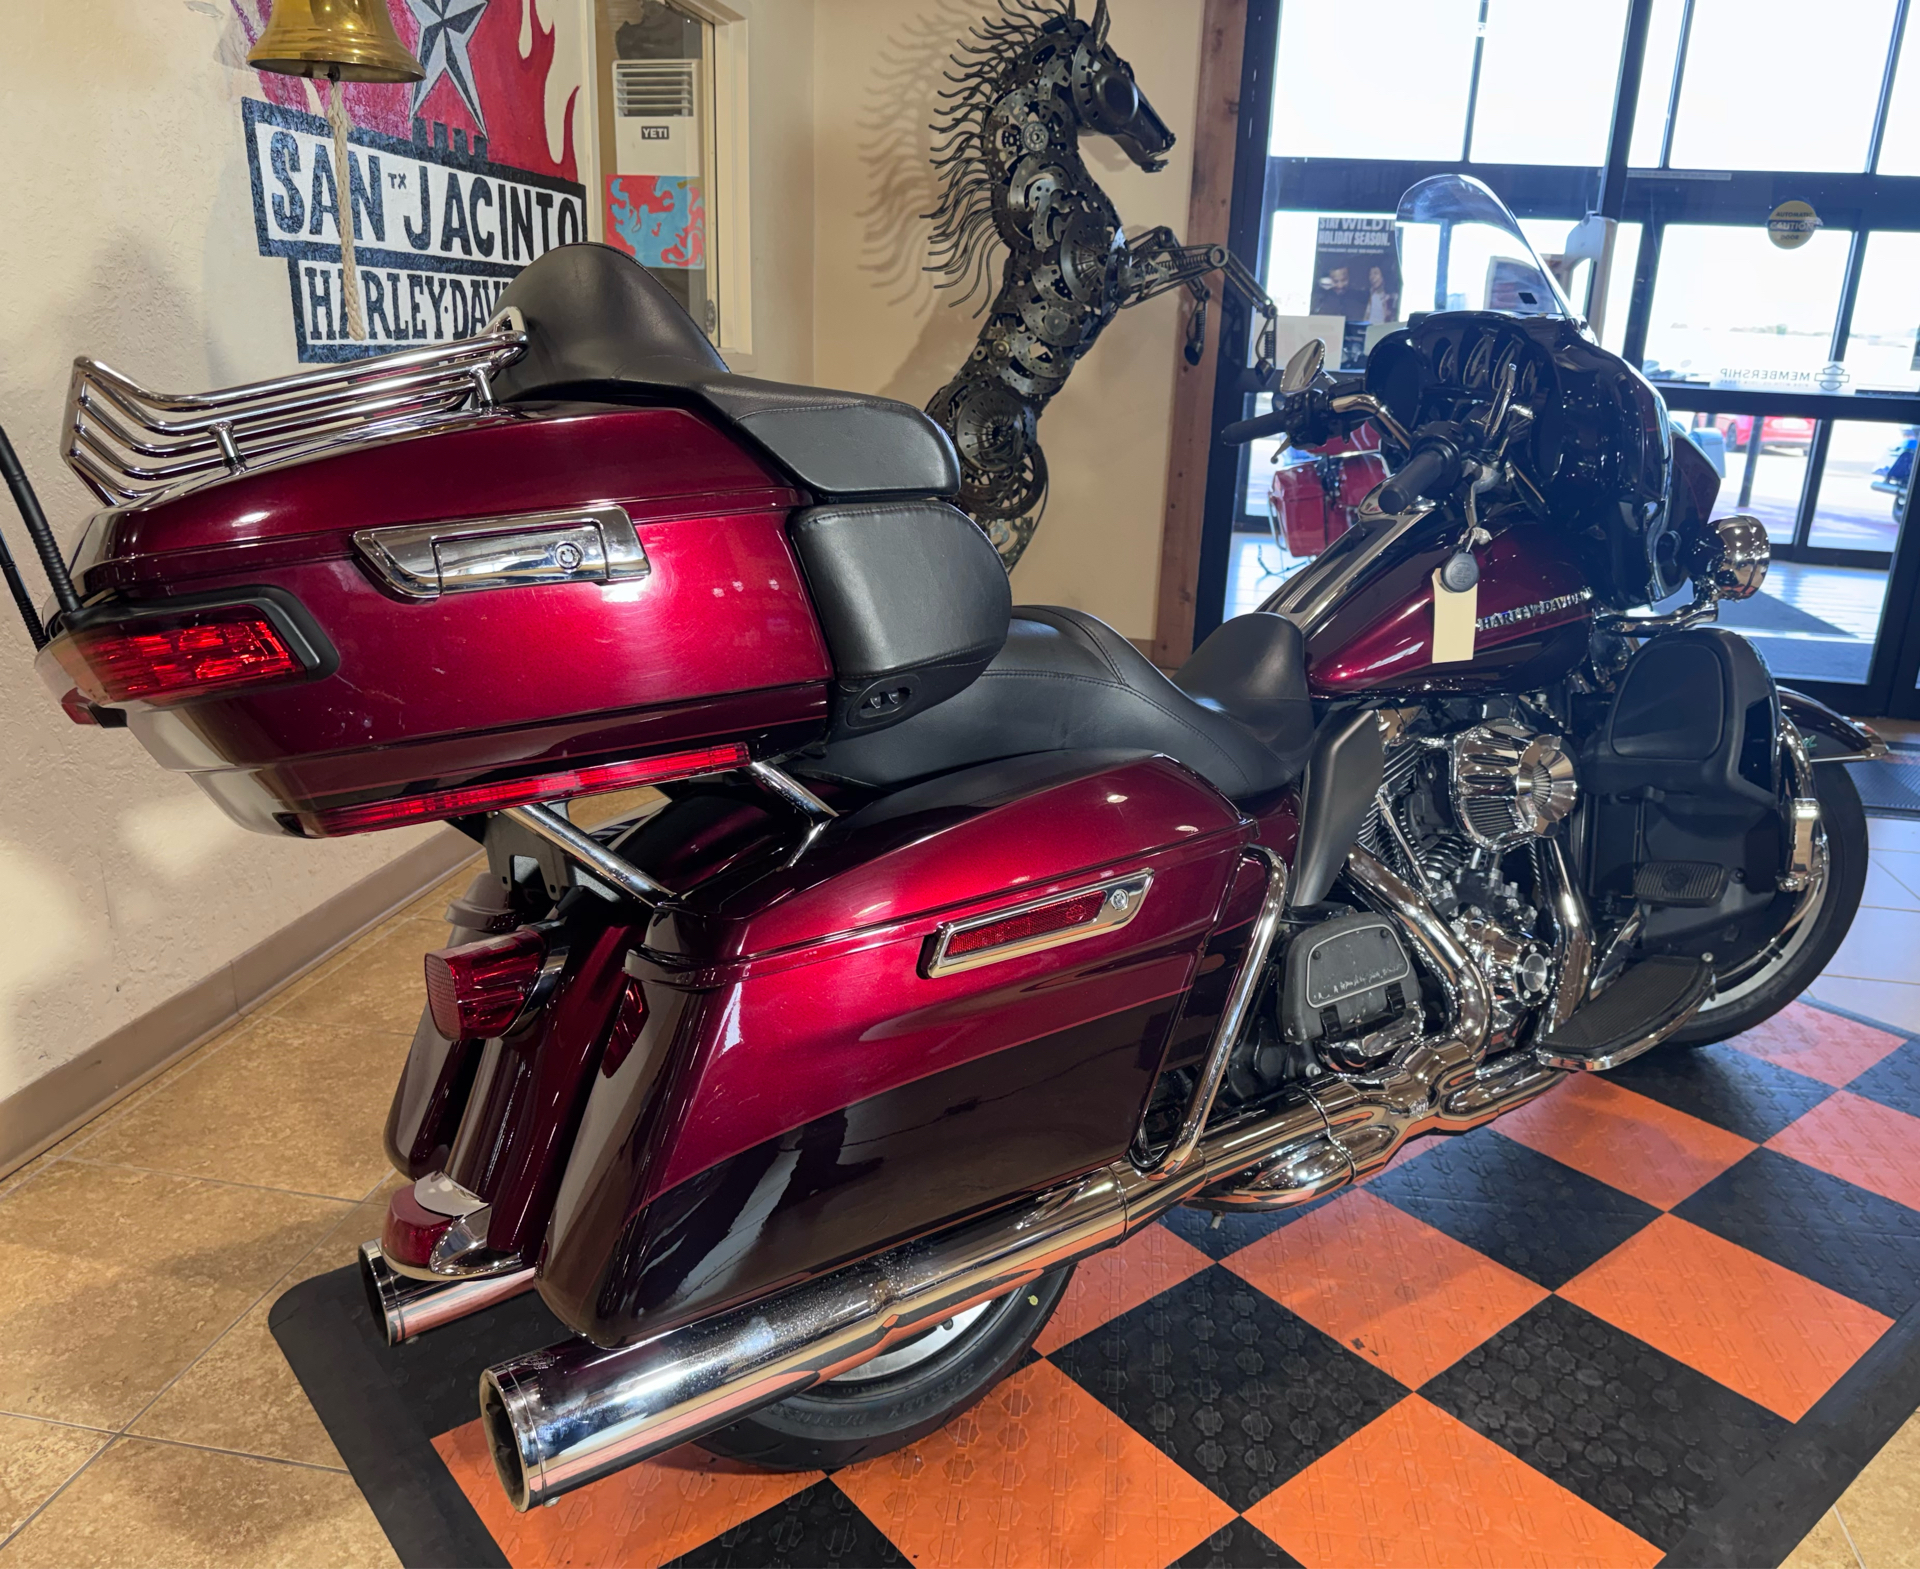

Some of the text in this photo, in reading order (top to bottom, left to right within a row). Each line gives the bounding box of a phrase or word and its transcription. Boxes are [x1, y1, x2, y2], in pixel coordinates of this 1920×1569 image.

[642, 127, 669, 138] YETI
[270, 130, 580, 262] SAN TX JACINTO
[1341, 218, 1385, 231] WILD
[1770, 221, 1815, 231] CAUTION
[1318, 230, 1391, 246] HOLIDAY SEASON.
